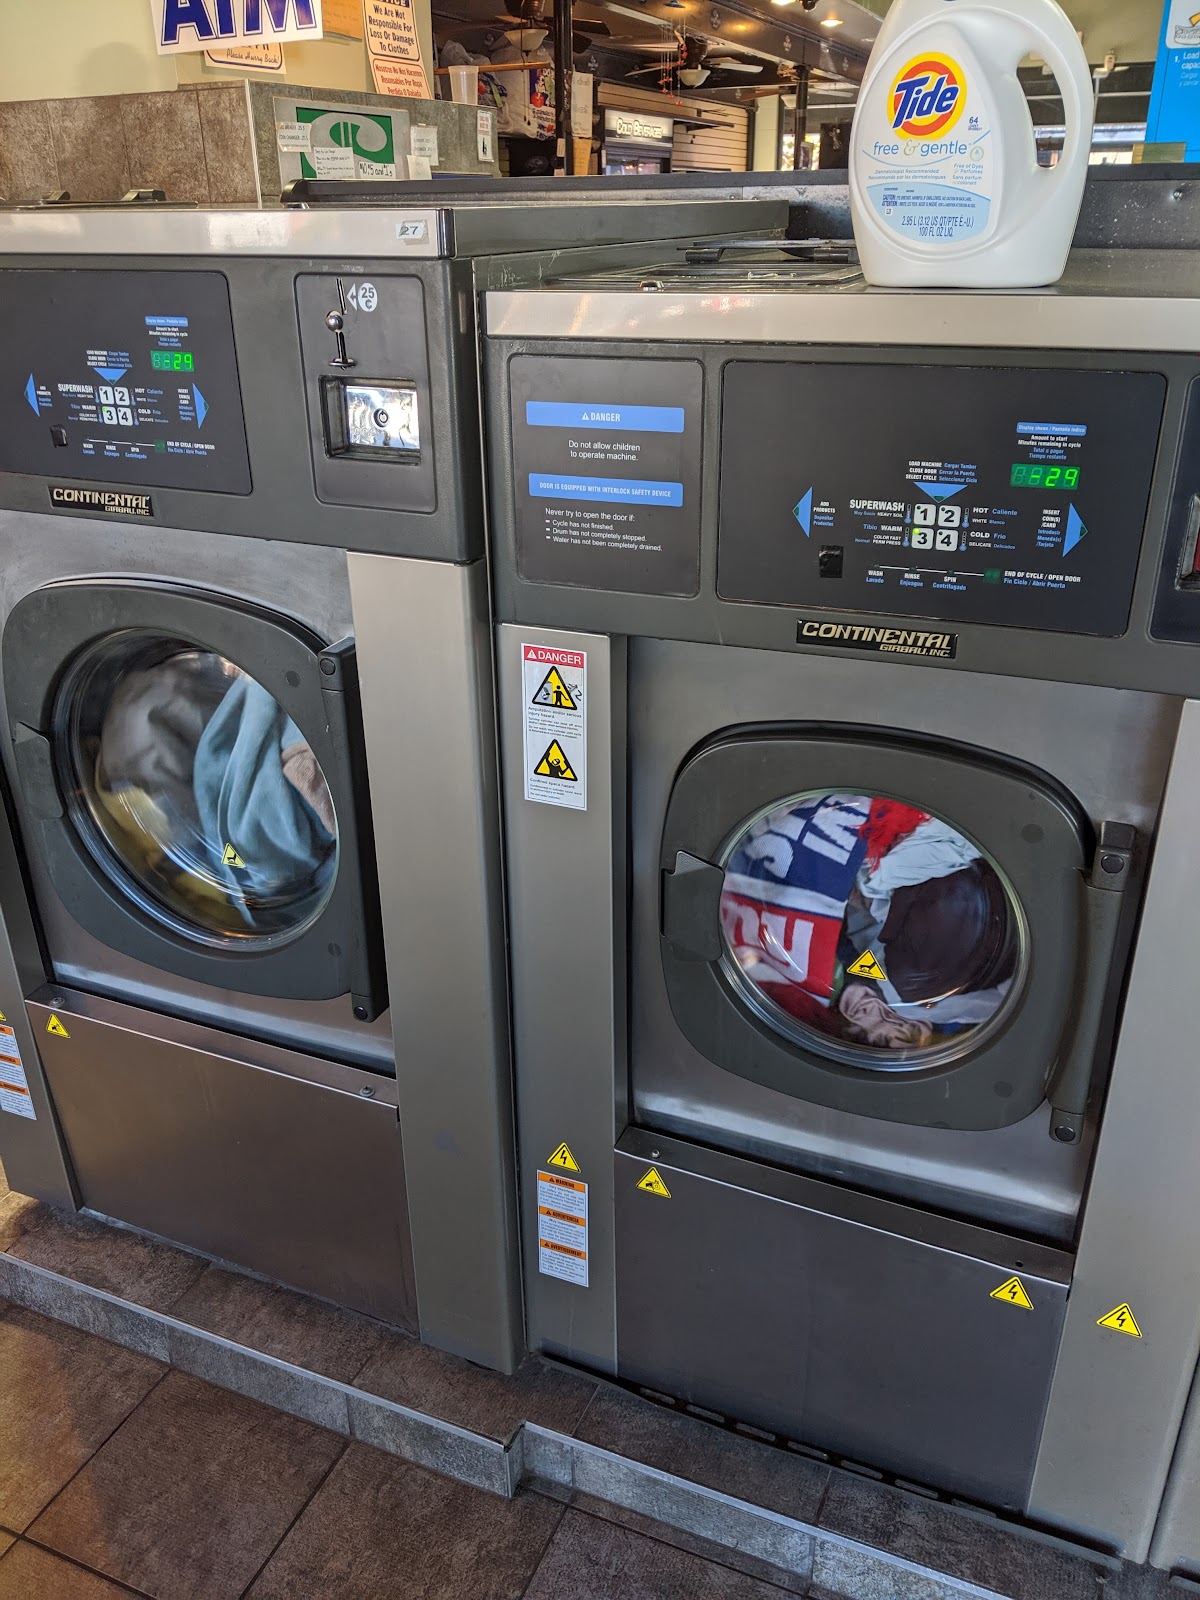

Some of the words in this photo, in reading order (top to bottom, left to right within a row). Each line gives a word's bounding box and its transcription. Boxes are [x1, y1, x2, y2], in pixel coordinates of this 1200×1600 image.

[373, 4, 382, 15] We
[385, 6, 394, 17] Are
[396, 9, 406, 20] Not
[368, 16, 402, 31] Responsible
[404, 23, 412, 33] For
[370, 28, 382, 39] Loss
[384, 31, 391, 40] Or
[392, 32, 414, 46] Damage
[380, 42, 386, 51] To
[388, 43, 409, 55] Clothes
[226, 49, 243, 60] Please
[245, 52, 263, 64] Hurry
[892, 74, 960, 129] Tide
[874, 142, 899, 155] free
[903, 139, 920, 156] &
[920, 140, 967, 157] gentle
[902, 216, 913, 226] 2.95
[914, 216, 917, 226] L
[918, 216, 930, 227] (3.12
[931, 216, 939, 226] US
[940, 217, 959, 226] QT/PTE
[401, 226, 419, 235] 27
[919, 227, 927, 236] 100
[929, 227, 935, 236] FL
[937, 227, 944, 237] OZ
[361, 287, 374, 299] 25
[58, 384, 94, 393] SUPERWASH
[103, 390, 109, 400] 1
[118, 391, 126, 401] 2
[107, 411, 113, 421] 3
[121, 412, 128, 422] 4
[590, 412, 621, 422] DANGER
[568, 440, 578, 448] Do
[593, 442, 611, 450] allow
[612, 443, 640, 451] children
[578, 451, 605, 459] operate
[602, 487, 630, 495] INTERLOCK
[53, 488, 149, 509] CONTINENTAL
[850, 499, 905, 511] SUPERWASH
[920, 508, 927, 521] 1
[944, 510, 955, 523] 2
[591, 532, 621, 540] completely
[917, 532, 928, 545] 3
[940, 533, 952, 546] 4
[608, 541, 638, 550] completely
[802, 622, 952, 649] CONTINENTAL
[538, 650, 582, 665] DANGER
[928, 648, 950, 657] INC.
